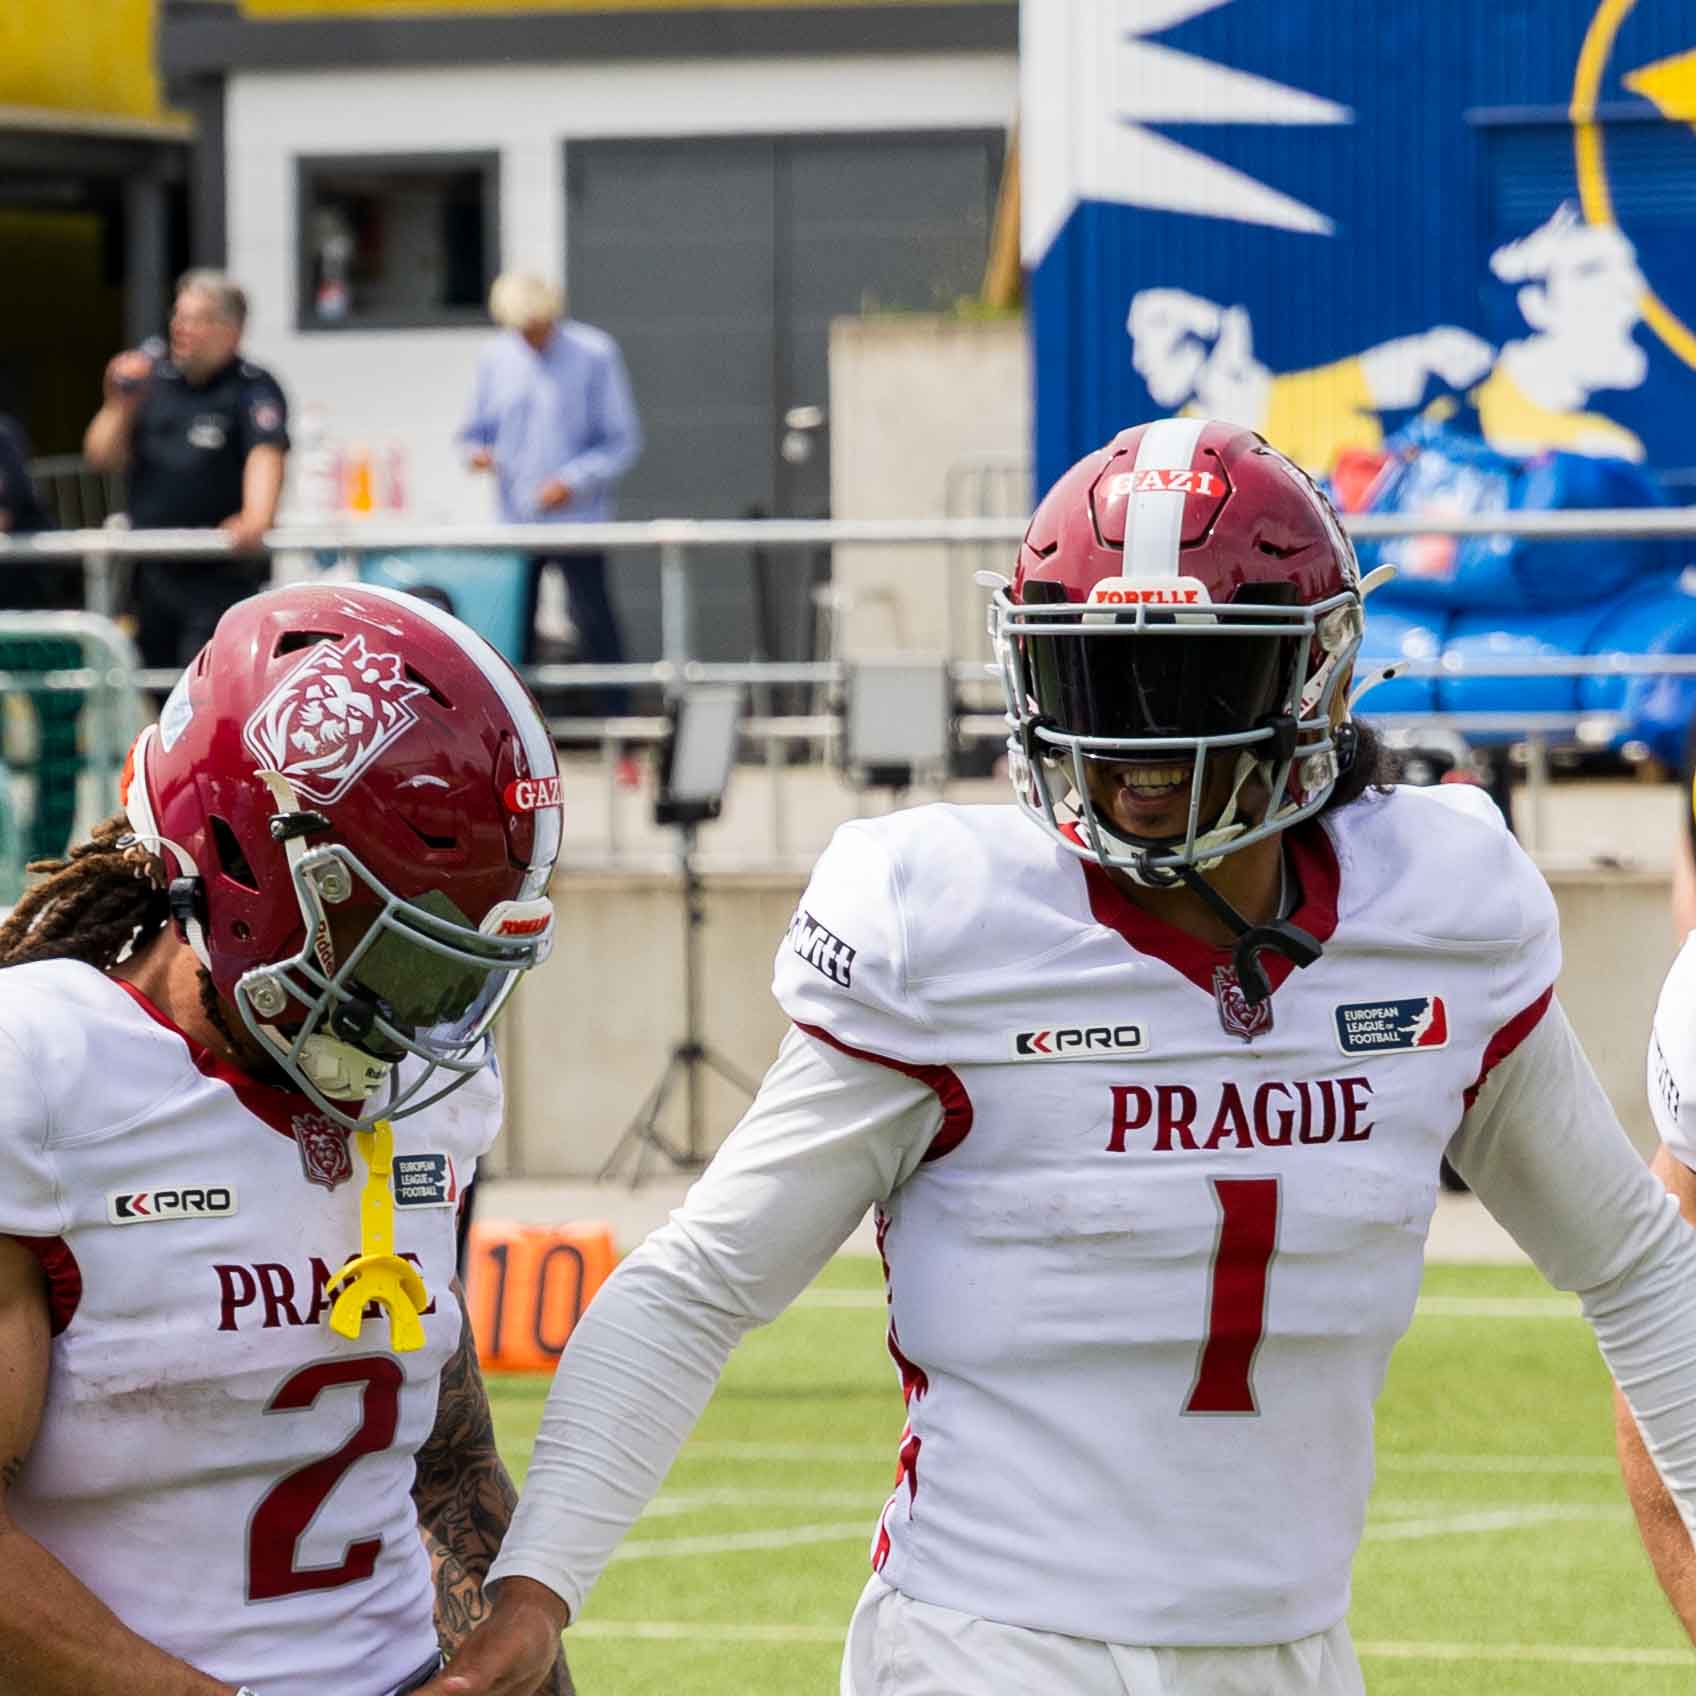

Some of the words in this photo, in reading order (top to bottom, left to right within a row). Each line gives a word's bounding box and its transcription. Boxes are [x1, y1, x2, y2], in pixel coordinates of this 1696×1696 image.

[515, 777, 566, 811] GAZ
[1344, 1006, 1400, 1021] EUROPEAN
[1346, 1021, 1385, 1033] LEAGUE
[1348, 1032, 1401, 1045] FOOTBALL
[1105, 1076, 1375, 1153] PRAGUE
[489, 1243, 584, 1358] 10
[1179, 1173, 1283, 1417] 1
[244, 1350, 407, 1606] 2
